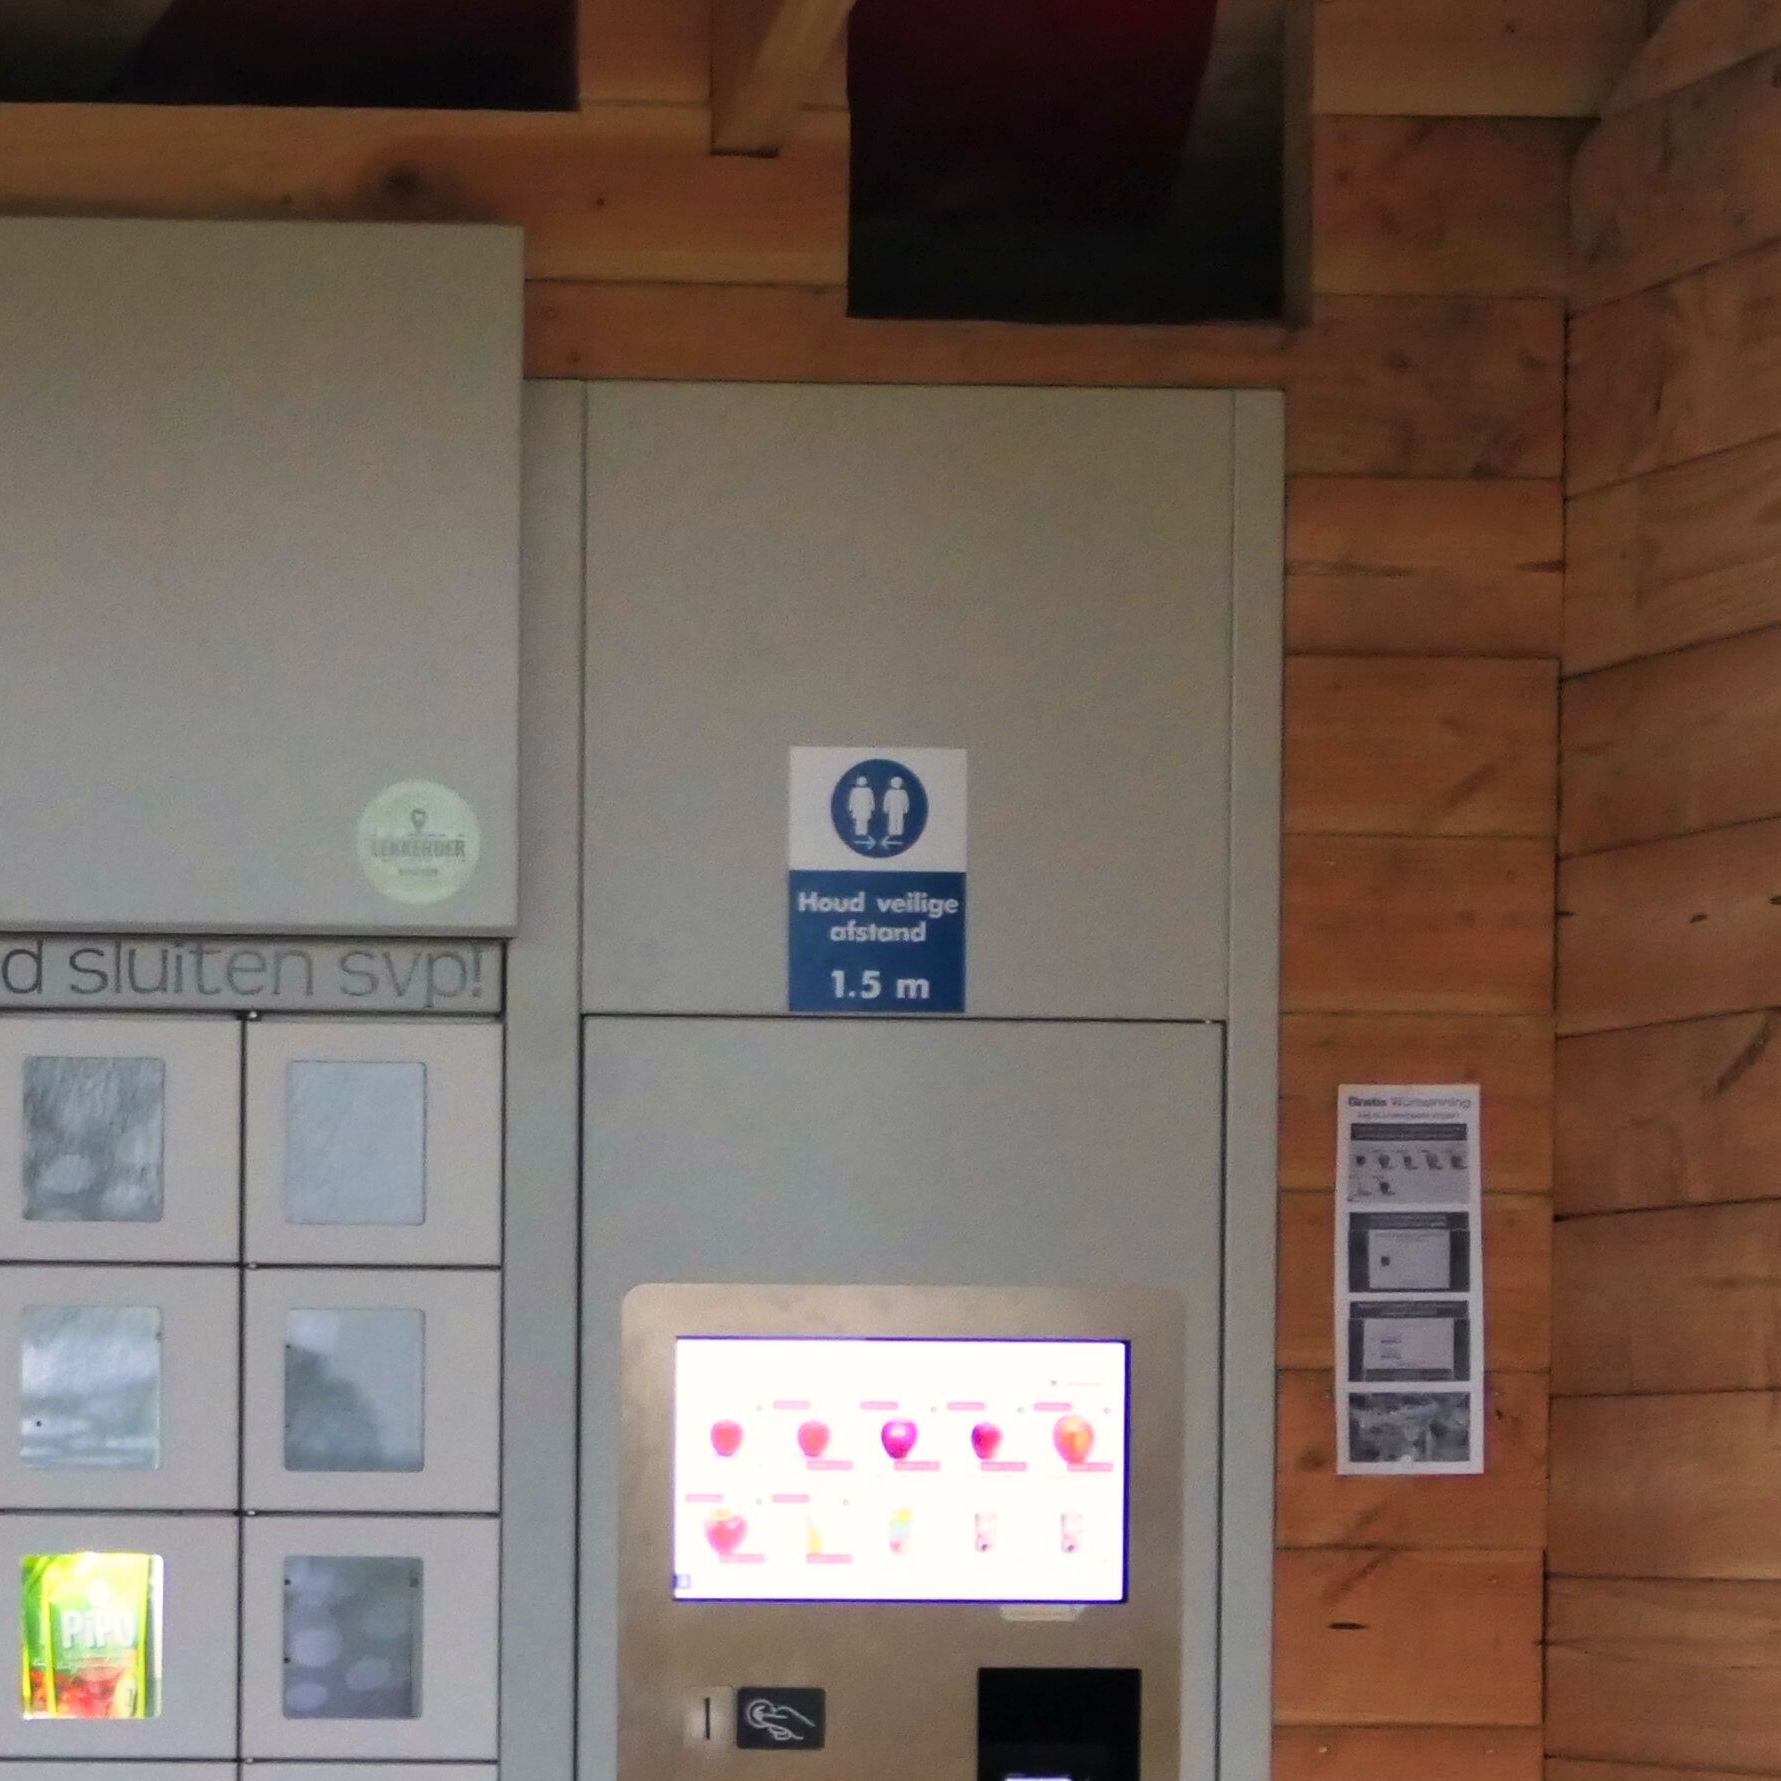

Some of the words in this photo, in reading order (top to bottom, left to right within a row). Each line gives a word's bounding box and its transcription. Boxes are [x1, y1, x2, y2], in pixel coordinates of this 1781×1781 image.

[797, 890, 866, 914] Houd
[876, 891, 960, 918] veilige
[829, 919, 927, 943] afstand
[68, 940, 314, 996] sluiten
[339, 943, 483, 1008] svp!
[830, 969, 882, 1000] 1.5
[895, 977, 930, 999] m
